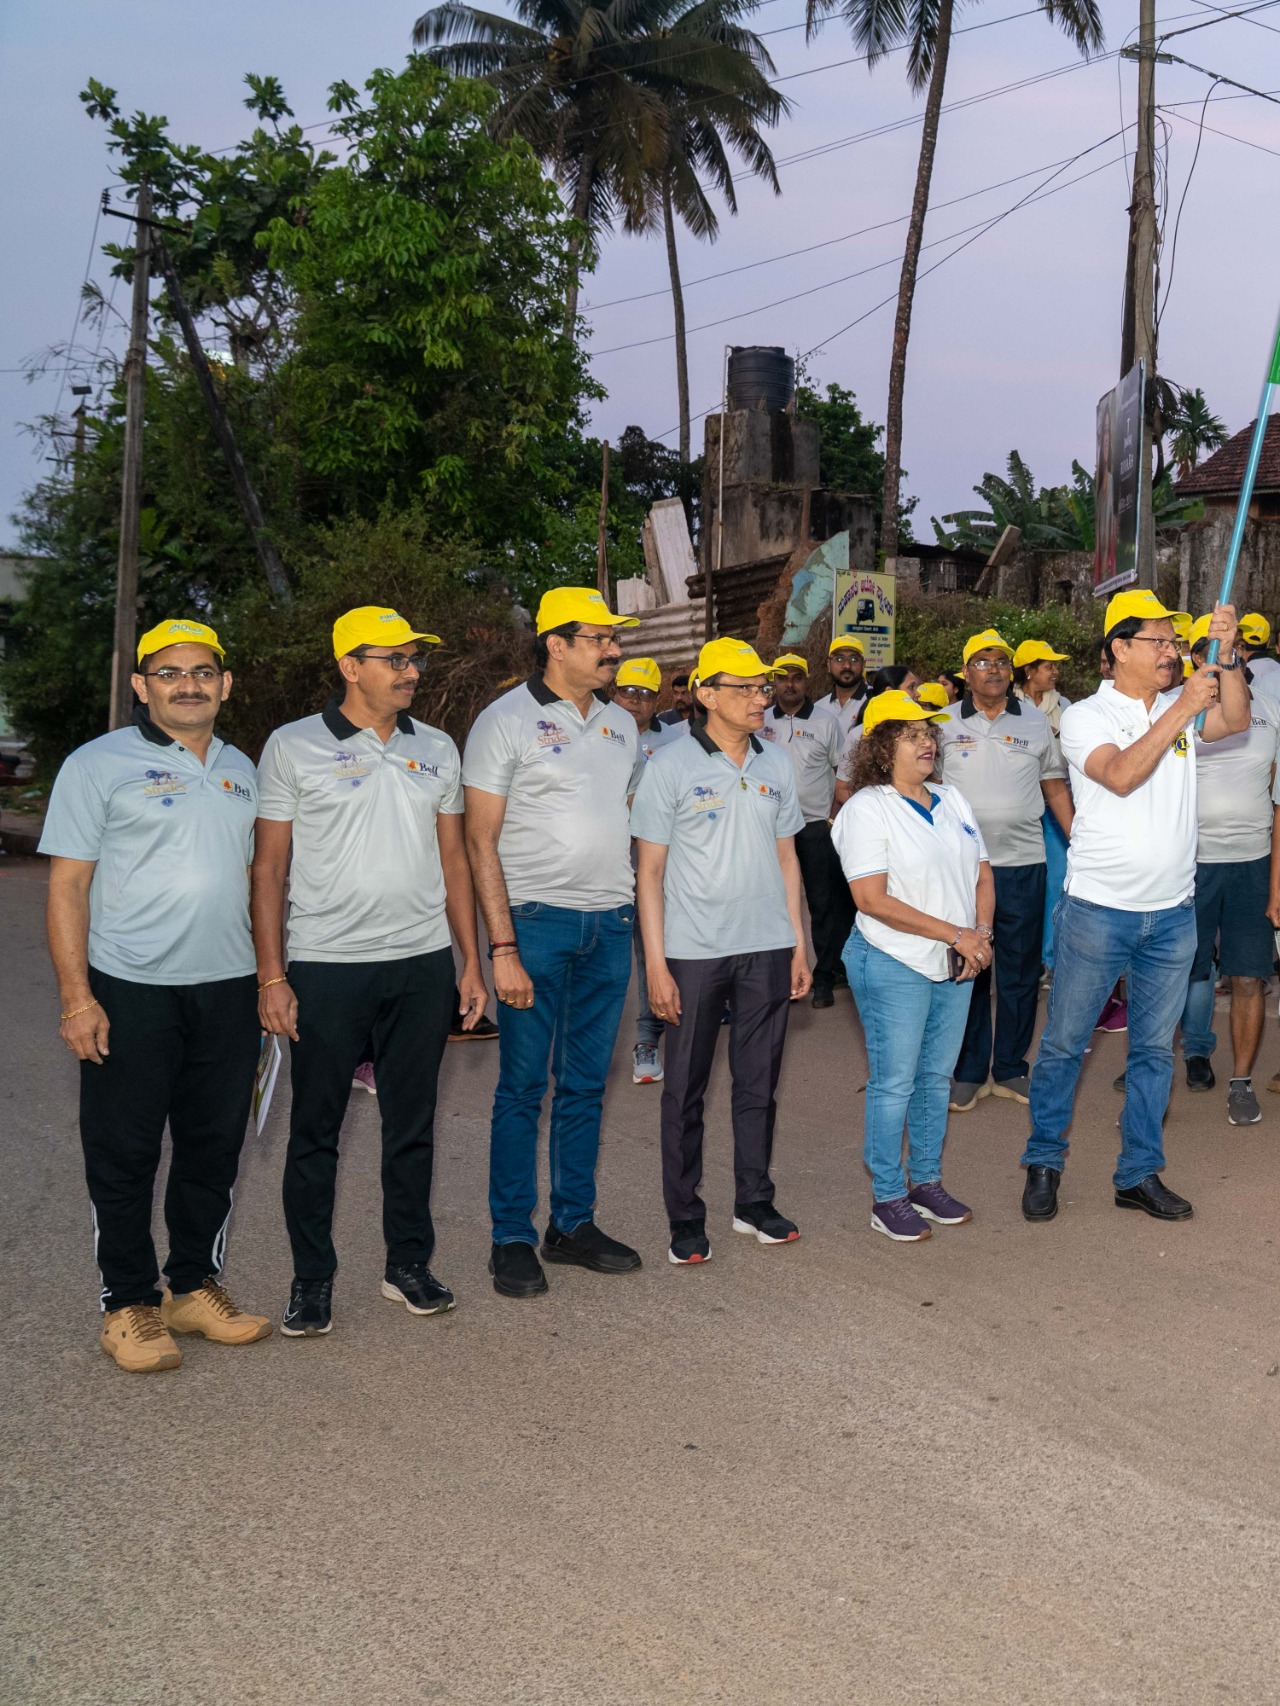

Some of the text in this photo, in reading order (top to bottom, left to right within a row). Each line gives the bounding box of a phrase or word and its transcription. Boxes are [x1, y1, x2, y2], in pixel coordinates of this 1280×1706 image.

[538, 735, 569, 746] Strides
[610, 729, 626, 744] Bell
[1013, 737, 1029, 747] Bell
[419, 762, 438, 776] Bell
